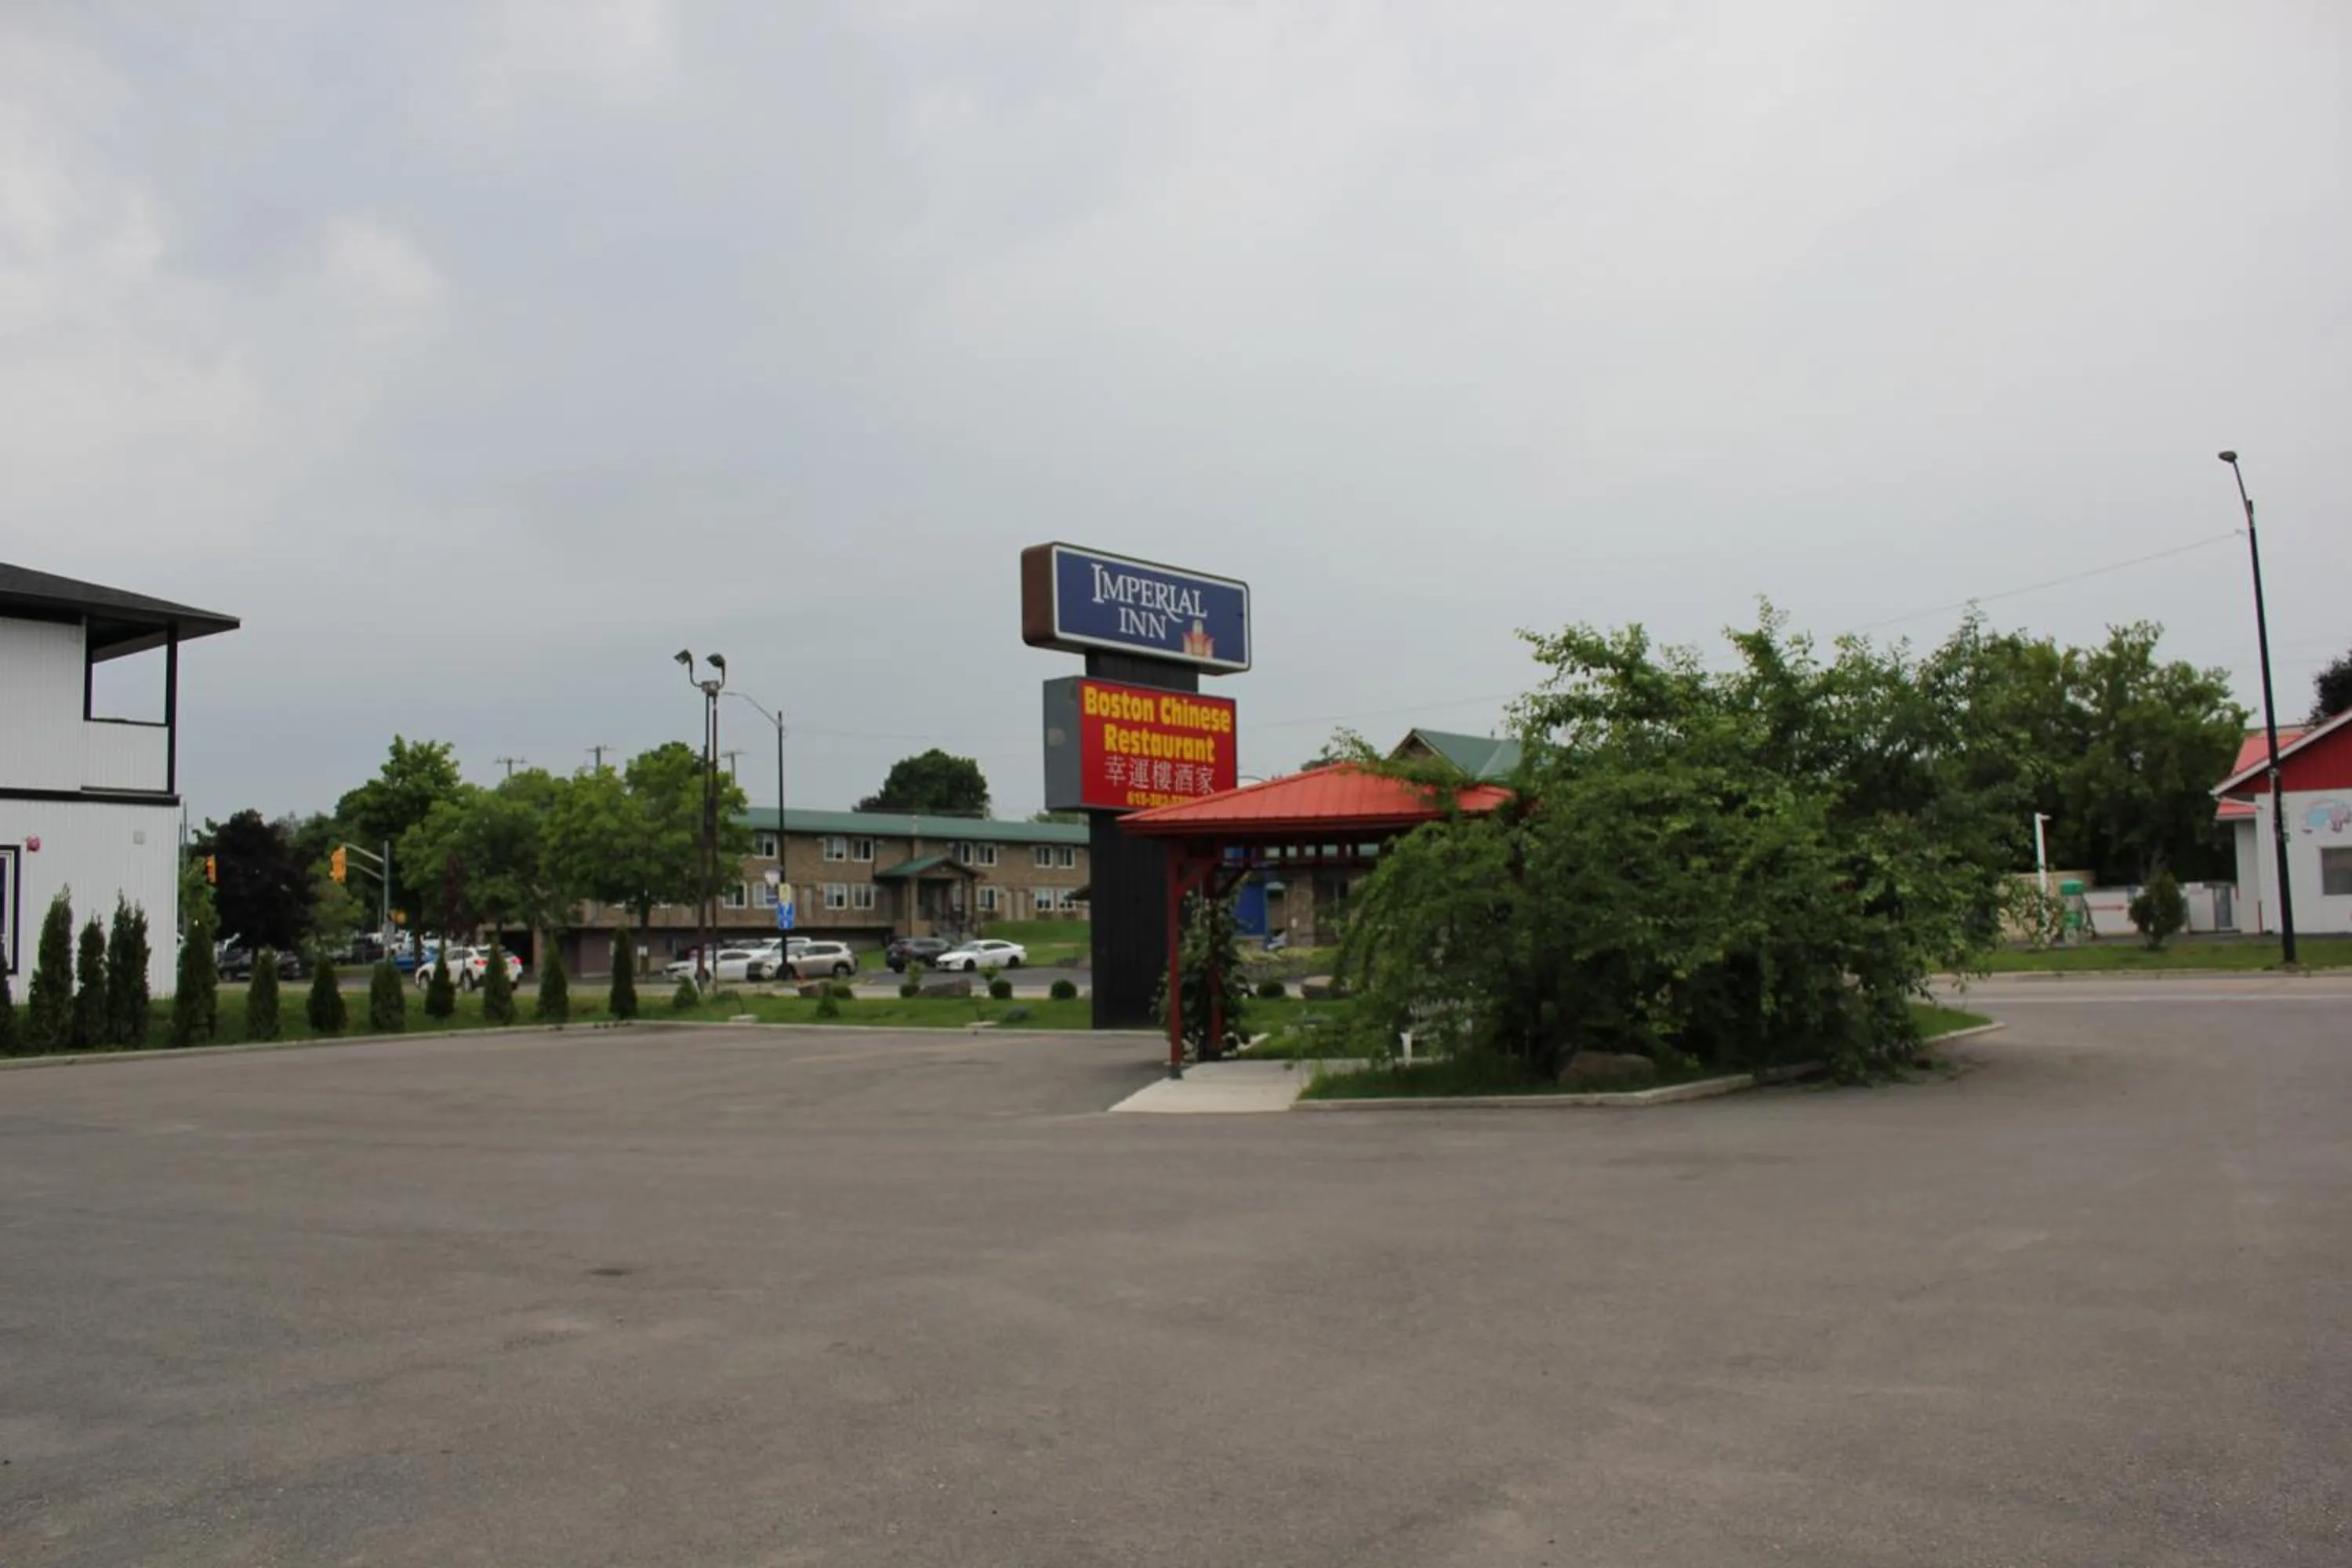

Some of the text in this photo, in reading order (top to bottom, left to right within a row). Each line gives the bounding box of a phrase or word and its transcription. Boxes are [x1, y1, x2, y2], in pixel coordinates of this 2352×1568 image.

[1091, 563, 1207, 623] IMPERIAL
[1119, 607, 1167, 641] INN
[1083, 685, 1231, 732] Boston Chinese
[1104, 723, 1214, 763] Restaurant
